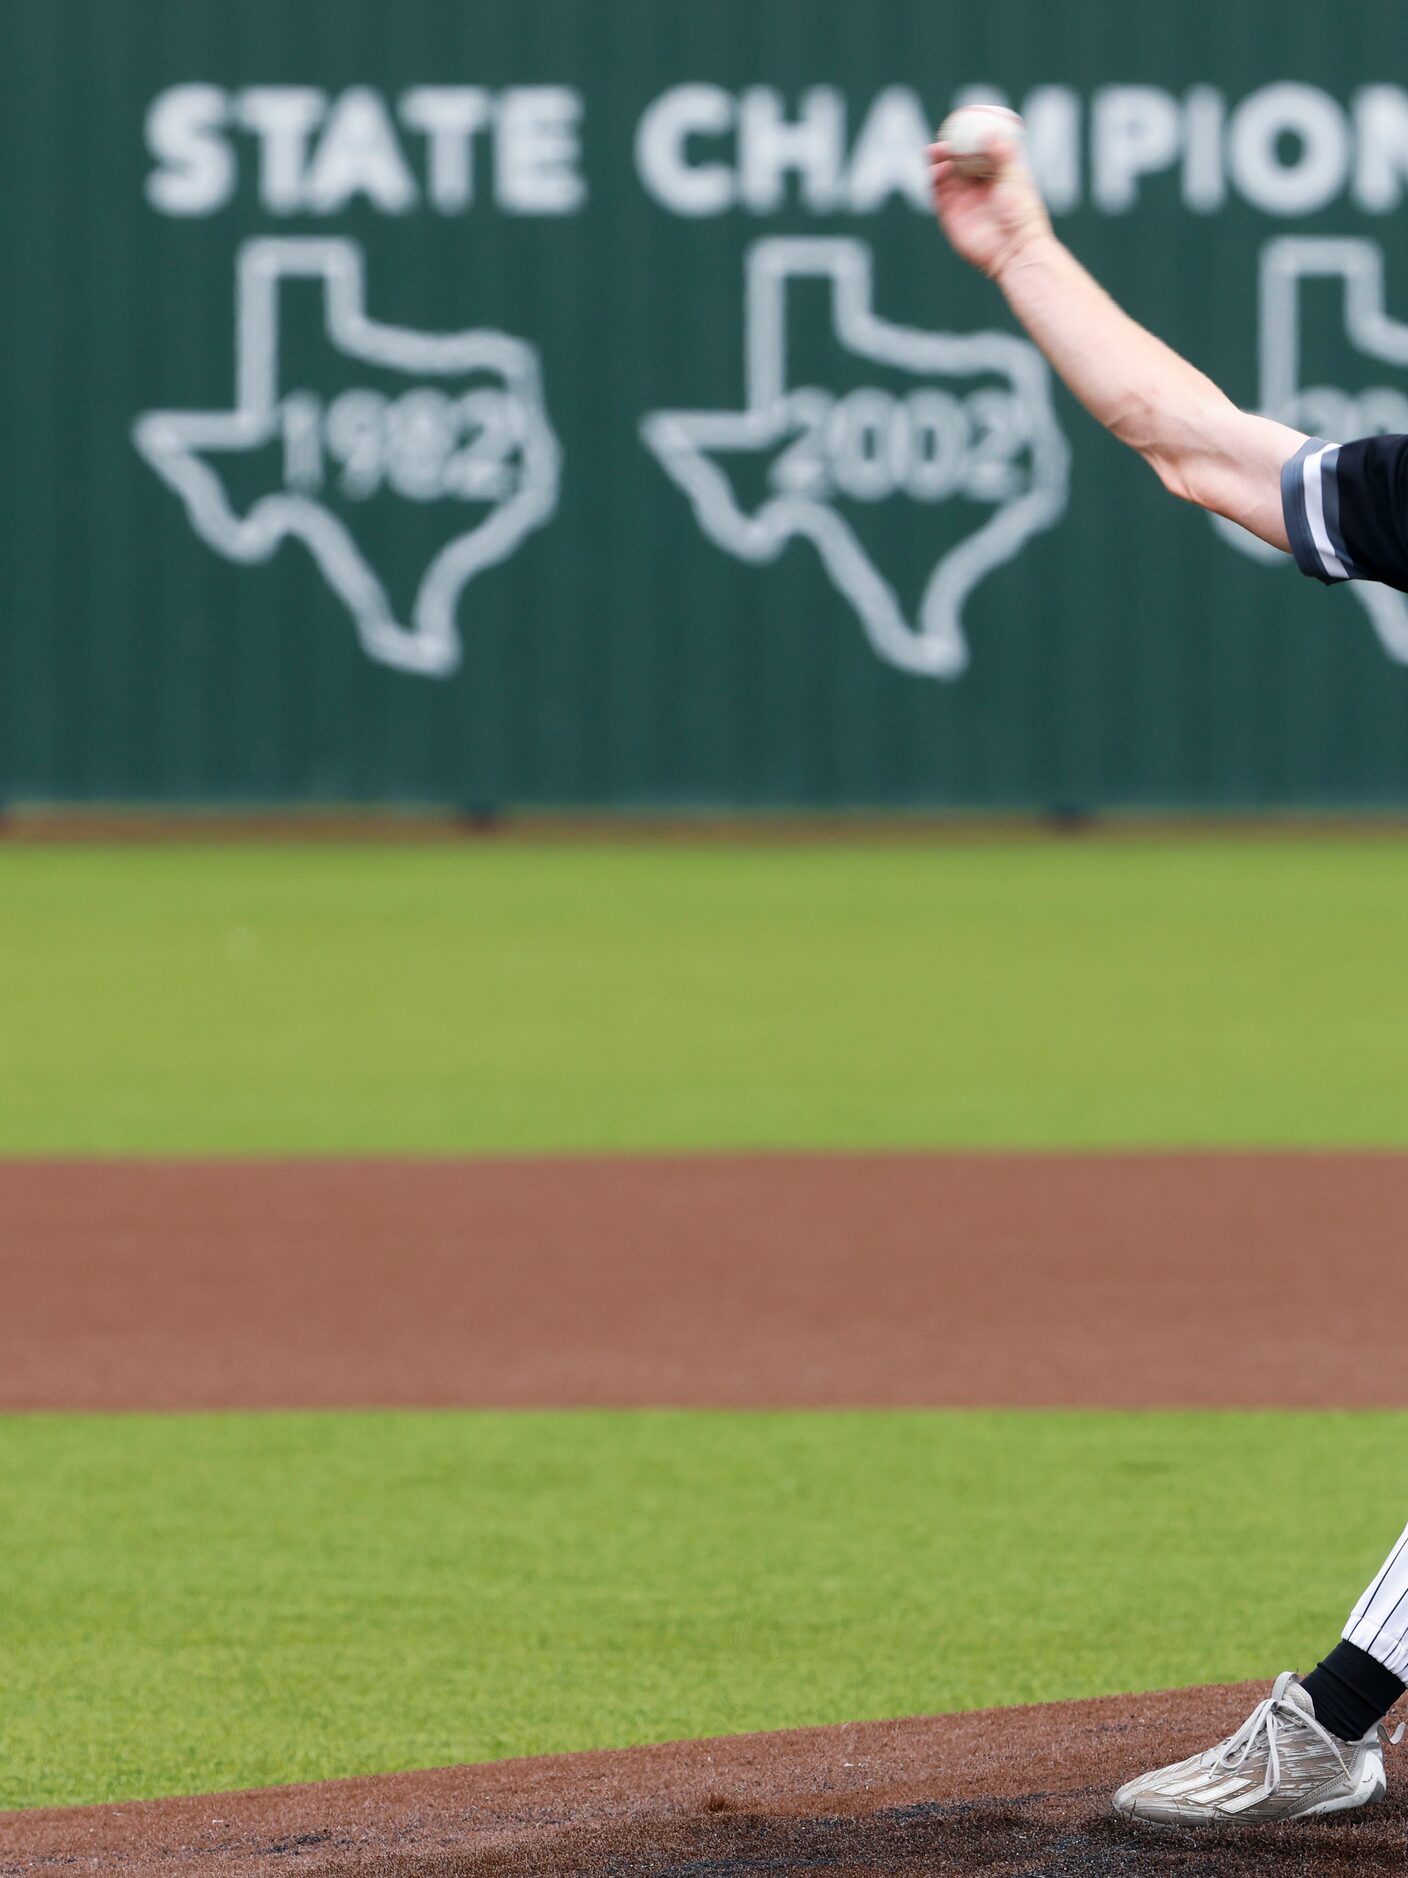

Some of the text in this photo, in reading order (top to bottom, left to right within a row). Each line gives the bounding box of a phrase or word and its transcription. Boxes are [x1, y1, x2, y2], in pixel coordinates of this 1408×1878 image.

[146, 83, 585, 214] STATE
[281, 388, 524, 500] 1982
[771, 388, 1022, 500] 2002
